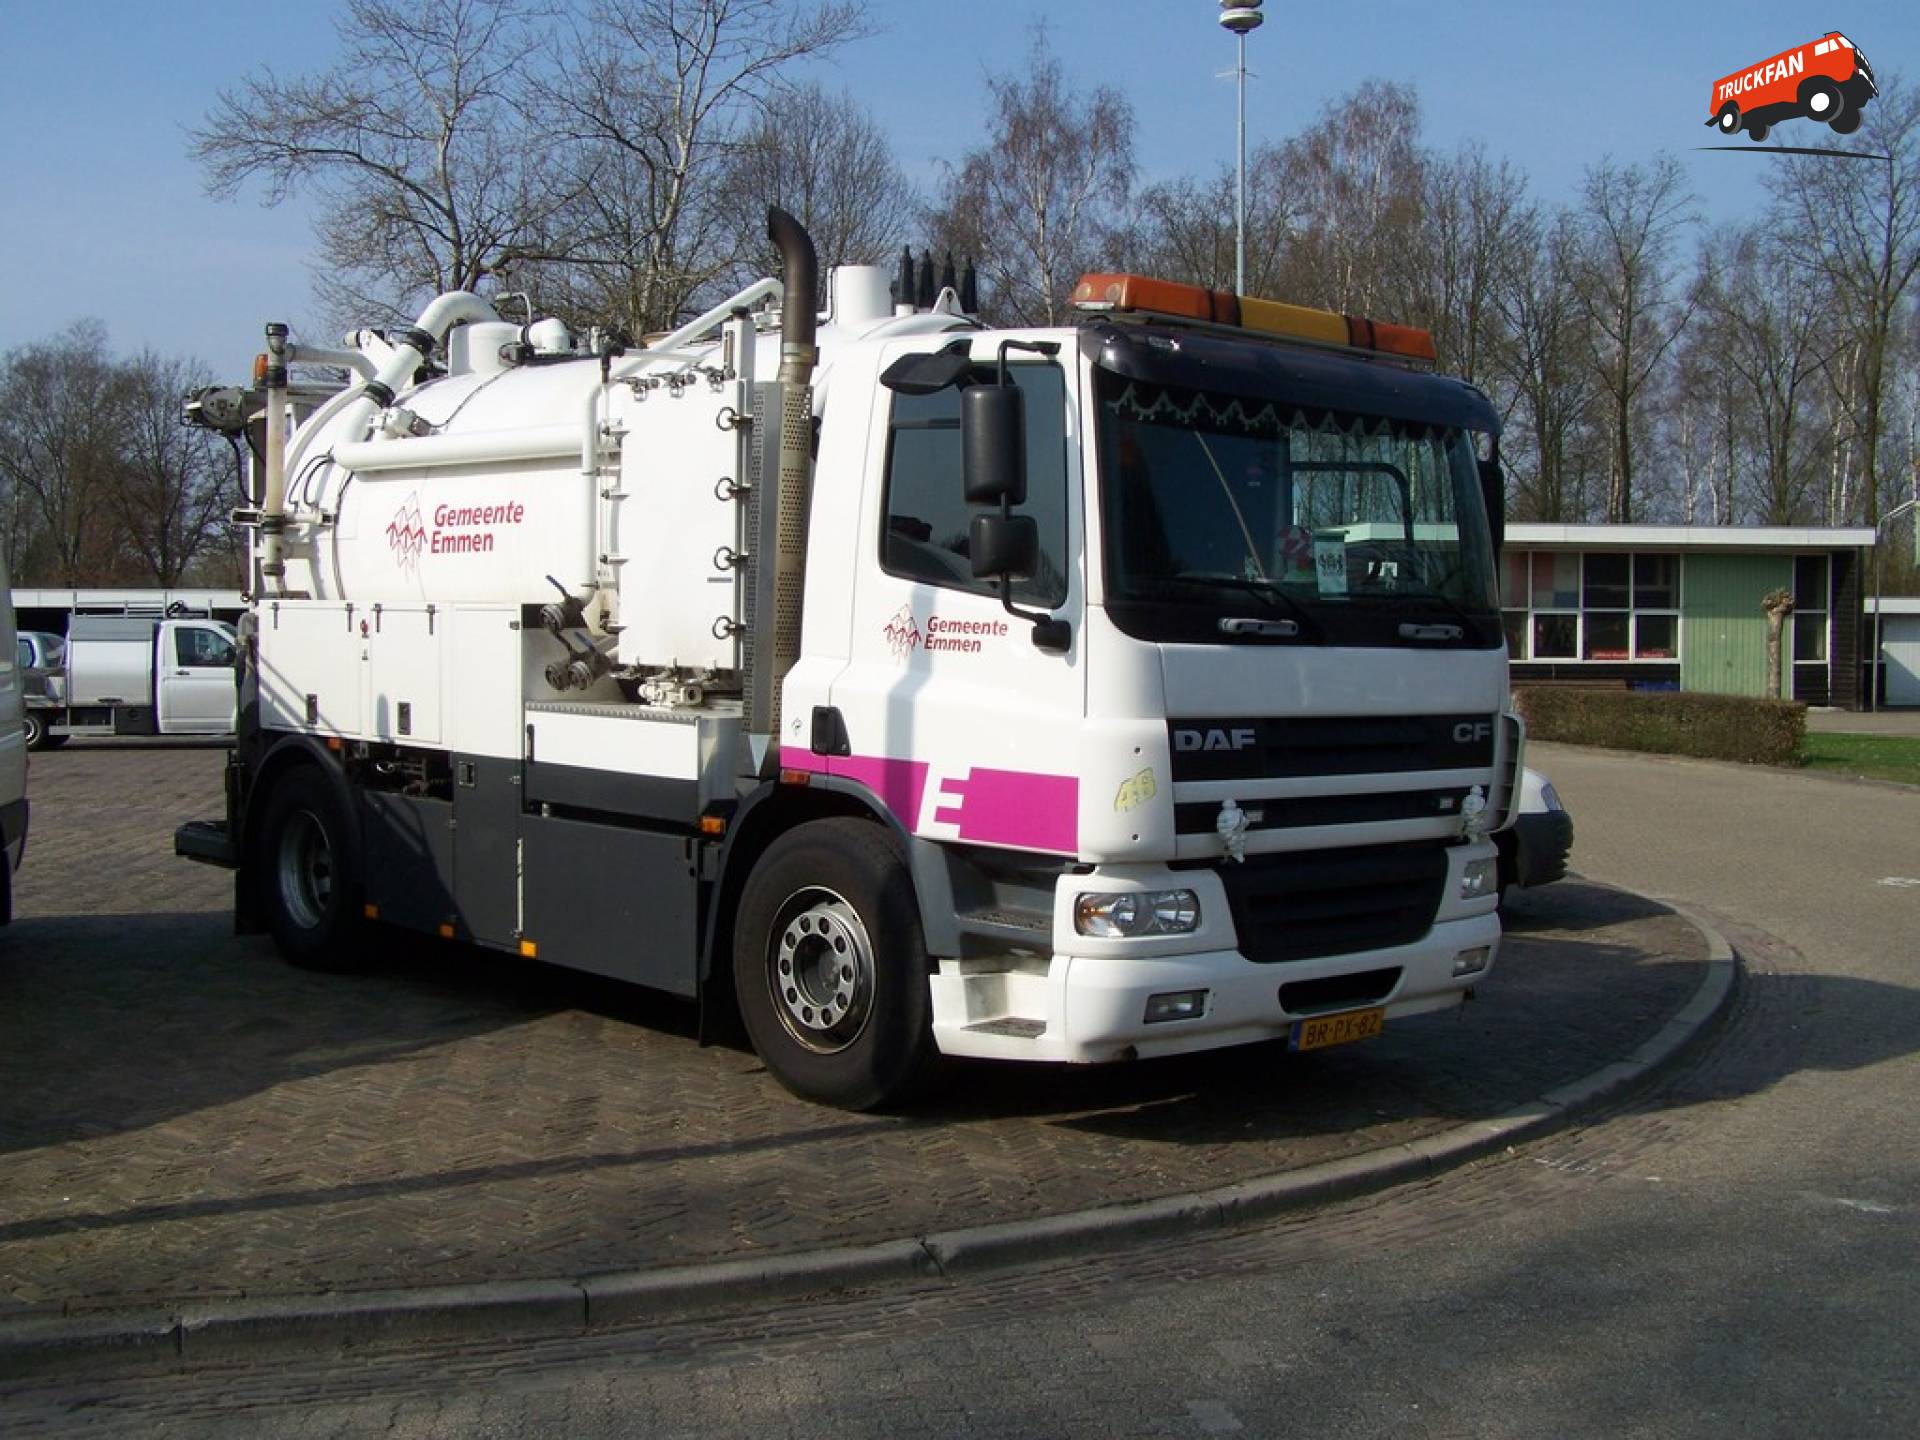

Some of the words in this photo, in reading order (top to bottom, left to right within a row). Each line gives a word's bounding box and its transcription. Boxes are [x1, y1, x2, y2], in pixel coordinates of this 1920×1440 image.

[434, 500, 524, 528] Gemeente
[430, 530, 494, 554] Emmen
[927, 615, 1009, 637] Gemeente
[923, 633, 982, 653] Emmen
[1174, 728, 1256, 751] DAF
[1453, 722, 1491, 743] CF
[1305, 1011, 1379, 1046] BR-PX-82
